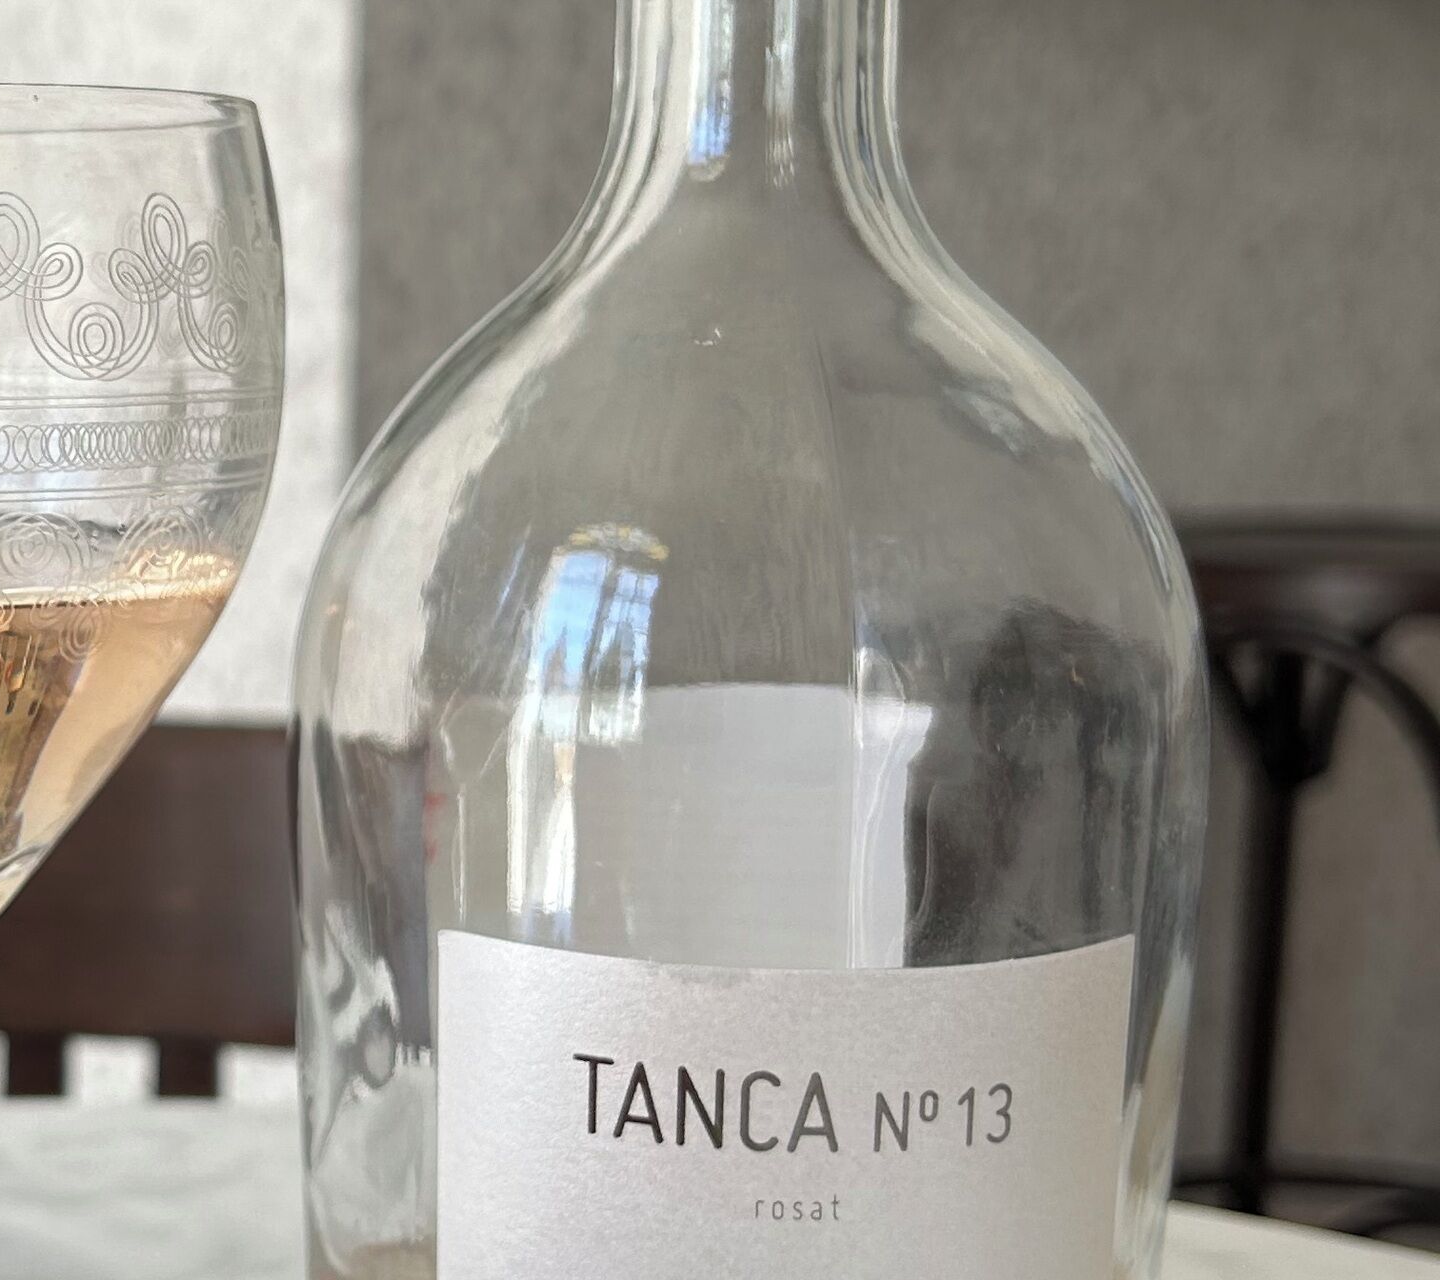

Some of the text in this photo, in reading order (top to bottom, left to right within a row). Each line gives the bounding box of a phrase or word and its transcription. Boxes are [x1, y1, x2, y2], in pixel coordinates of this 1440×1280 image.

[572, 1053, 840, 1153] TANCA
[957, 1083, 1014, 1147] 13
[754, 1194, 842, 1221] rosat
